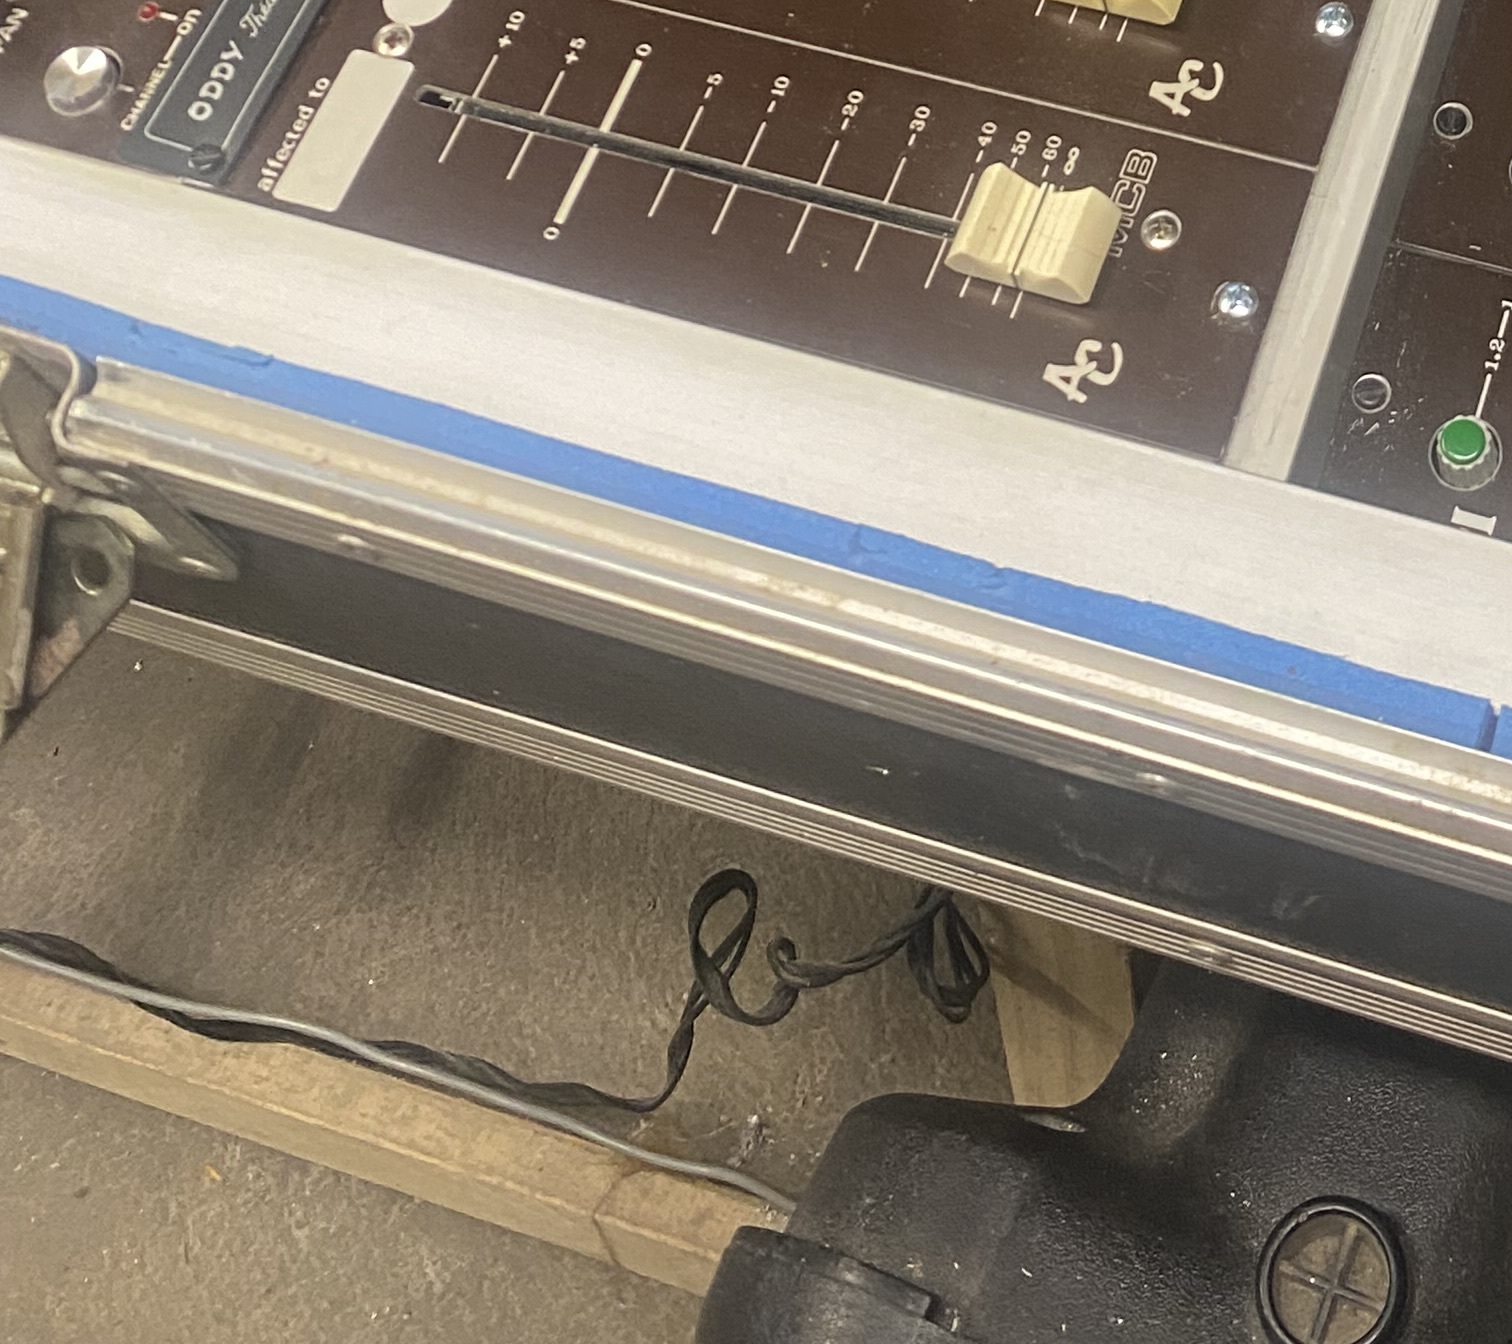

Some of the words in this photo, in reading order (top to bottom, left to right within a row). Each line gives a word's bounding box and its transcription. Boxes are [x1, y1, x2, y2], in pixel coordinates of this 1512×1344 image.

[635, 42, 652, 57] 0
[188, 40, 243, 120] ODDY
[257, 106, 315, 192] affected
[308, 77, 331, 100] to
[542, 226, 560, 240] 0
